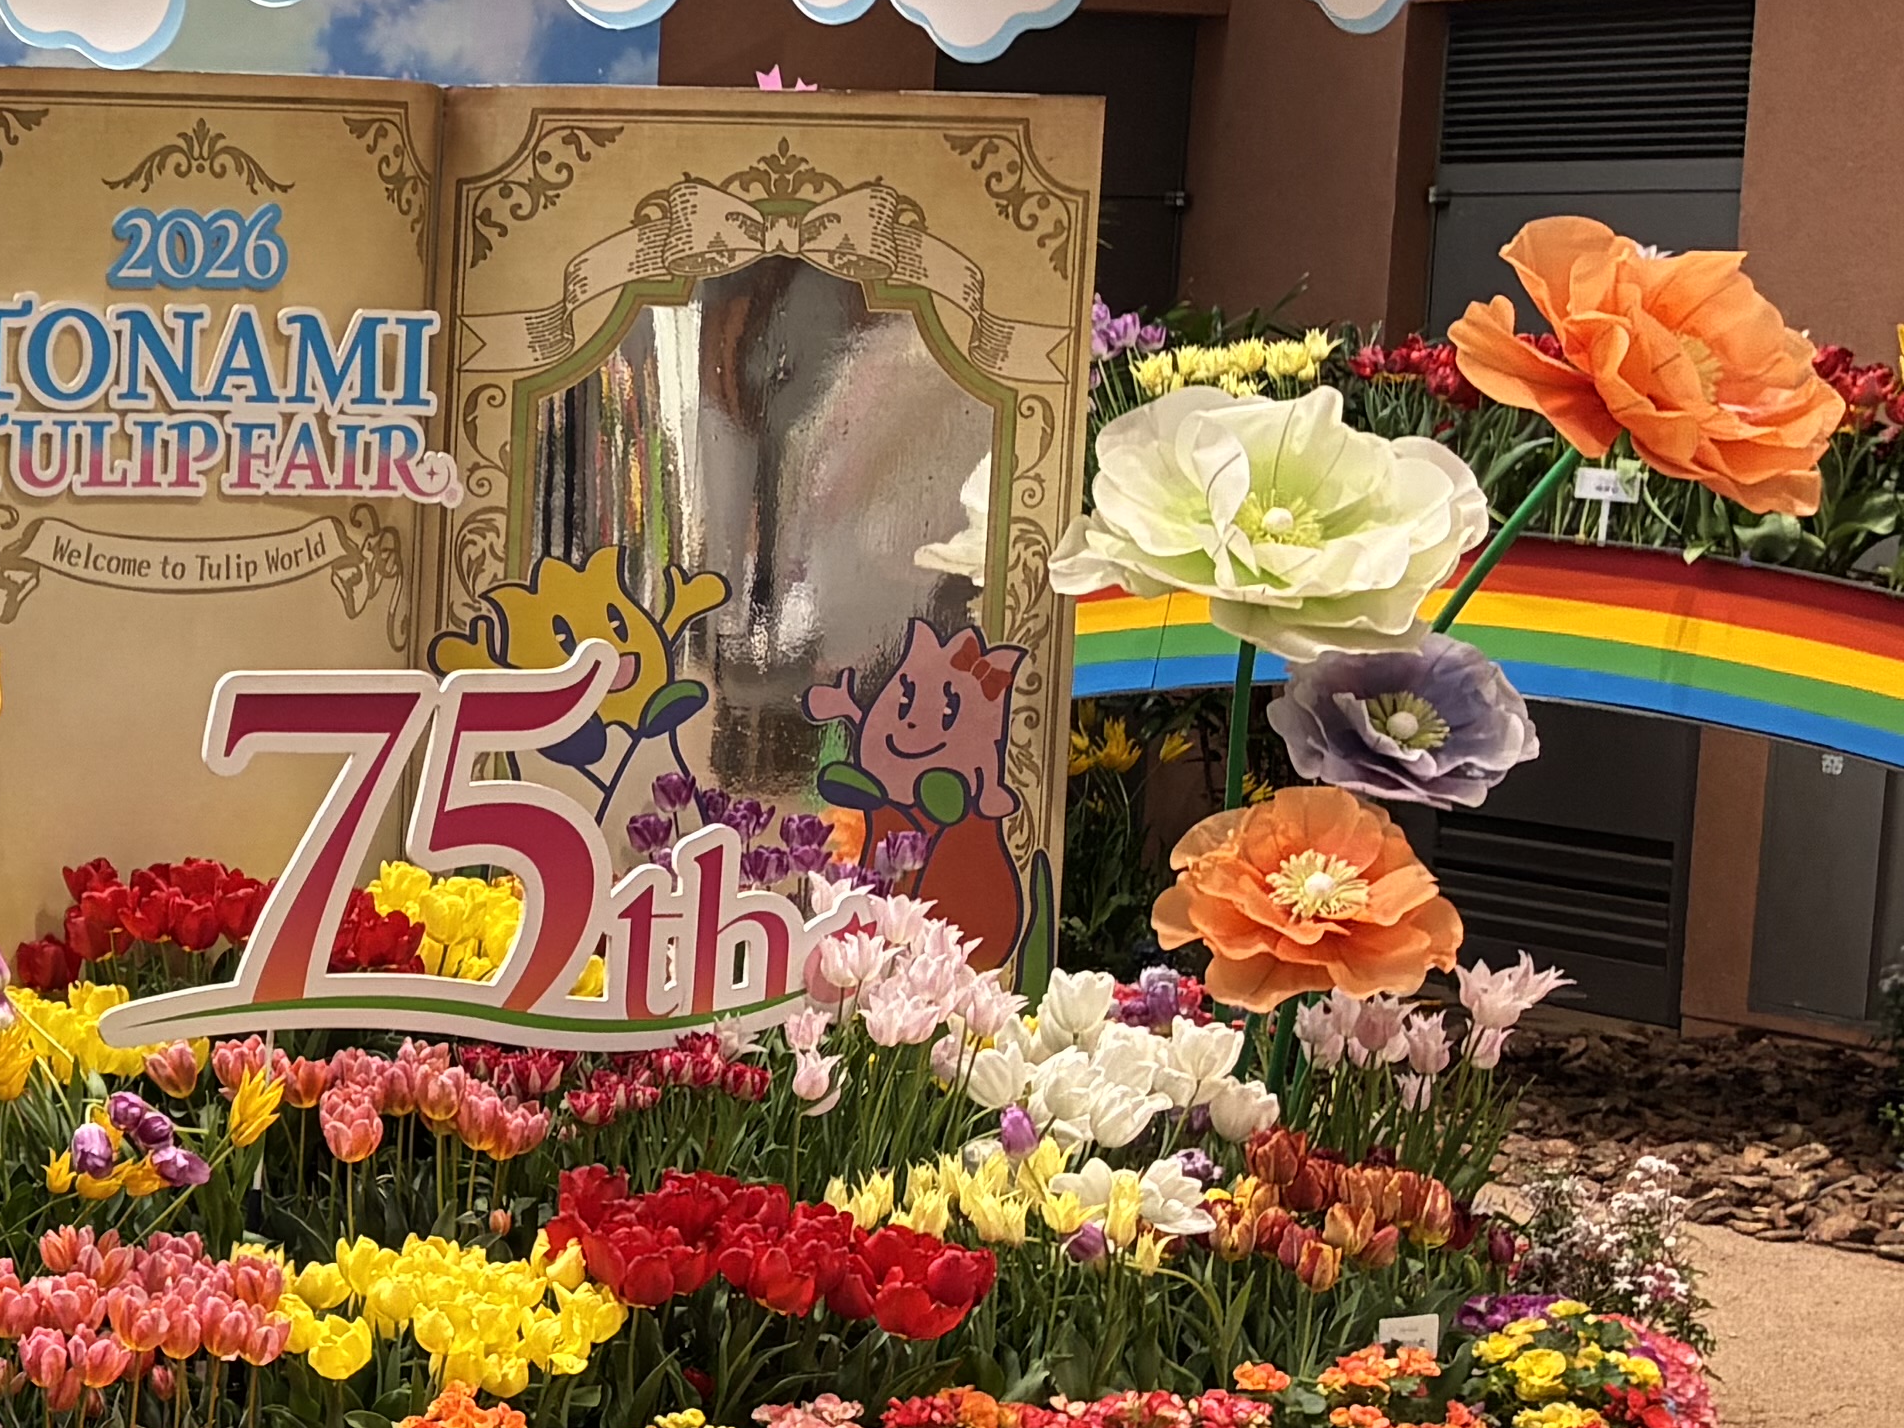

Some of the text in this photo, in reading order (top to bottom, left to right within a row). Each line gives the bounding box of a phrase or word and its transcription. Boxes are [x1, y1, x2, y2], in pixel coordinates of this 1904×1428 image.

[111, 206, 286, 285] 2026
[52, 532, 327, 583] Welcome to Tulip World
